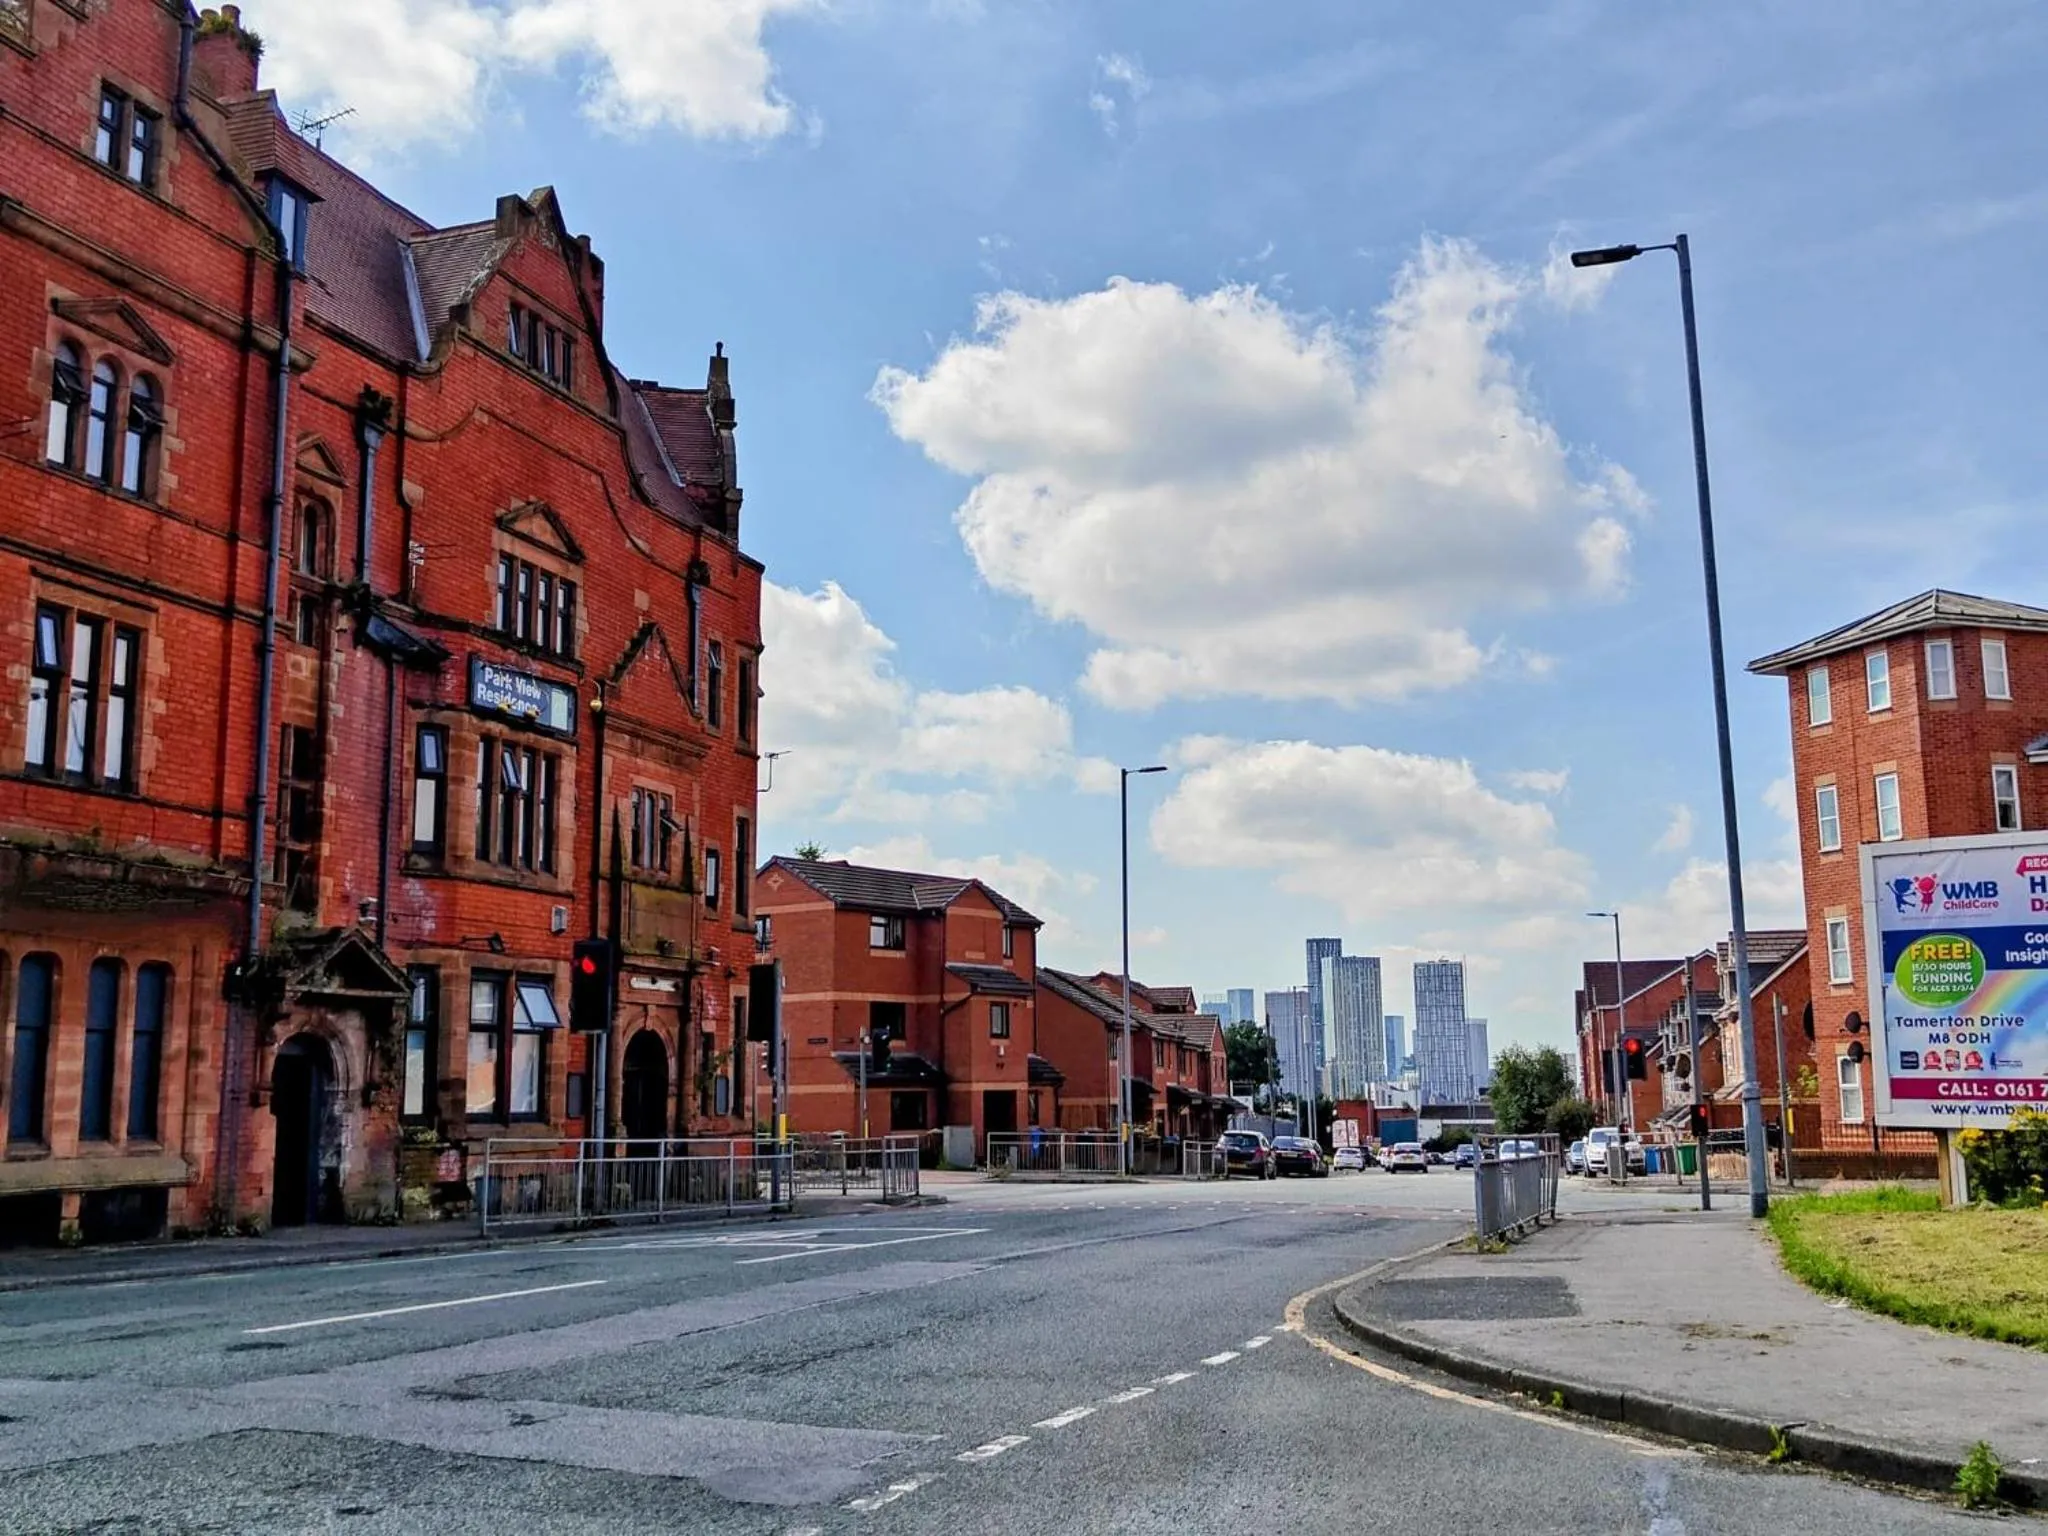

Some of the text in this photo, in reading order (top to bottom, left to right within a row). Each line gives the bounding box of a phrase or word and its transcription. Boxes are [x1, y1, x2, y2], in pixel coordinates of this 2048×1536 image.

[484, 667, 542, 700] Park View
[477, 683, 539, 714] Residence
[1942, 881, 1998, 900] WMB
[1943, 899, 1999, 911] ChildCare
[1910, 942, 1972, 960] FREE!
[1939, 962, 1972, 971] HOURS
[1912, 972, 1973, 984] FUNDING
[1894, 1013, 2025, 1027] Tamerton Drive
[1928, 1032, 1950, 1044] M8
[1938, 1082, 1988, 1096] CALL:
[1994, 1082, 2034, 1097] 0161
